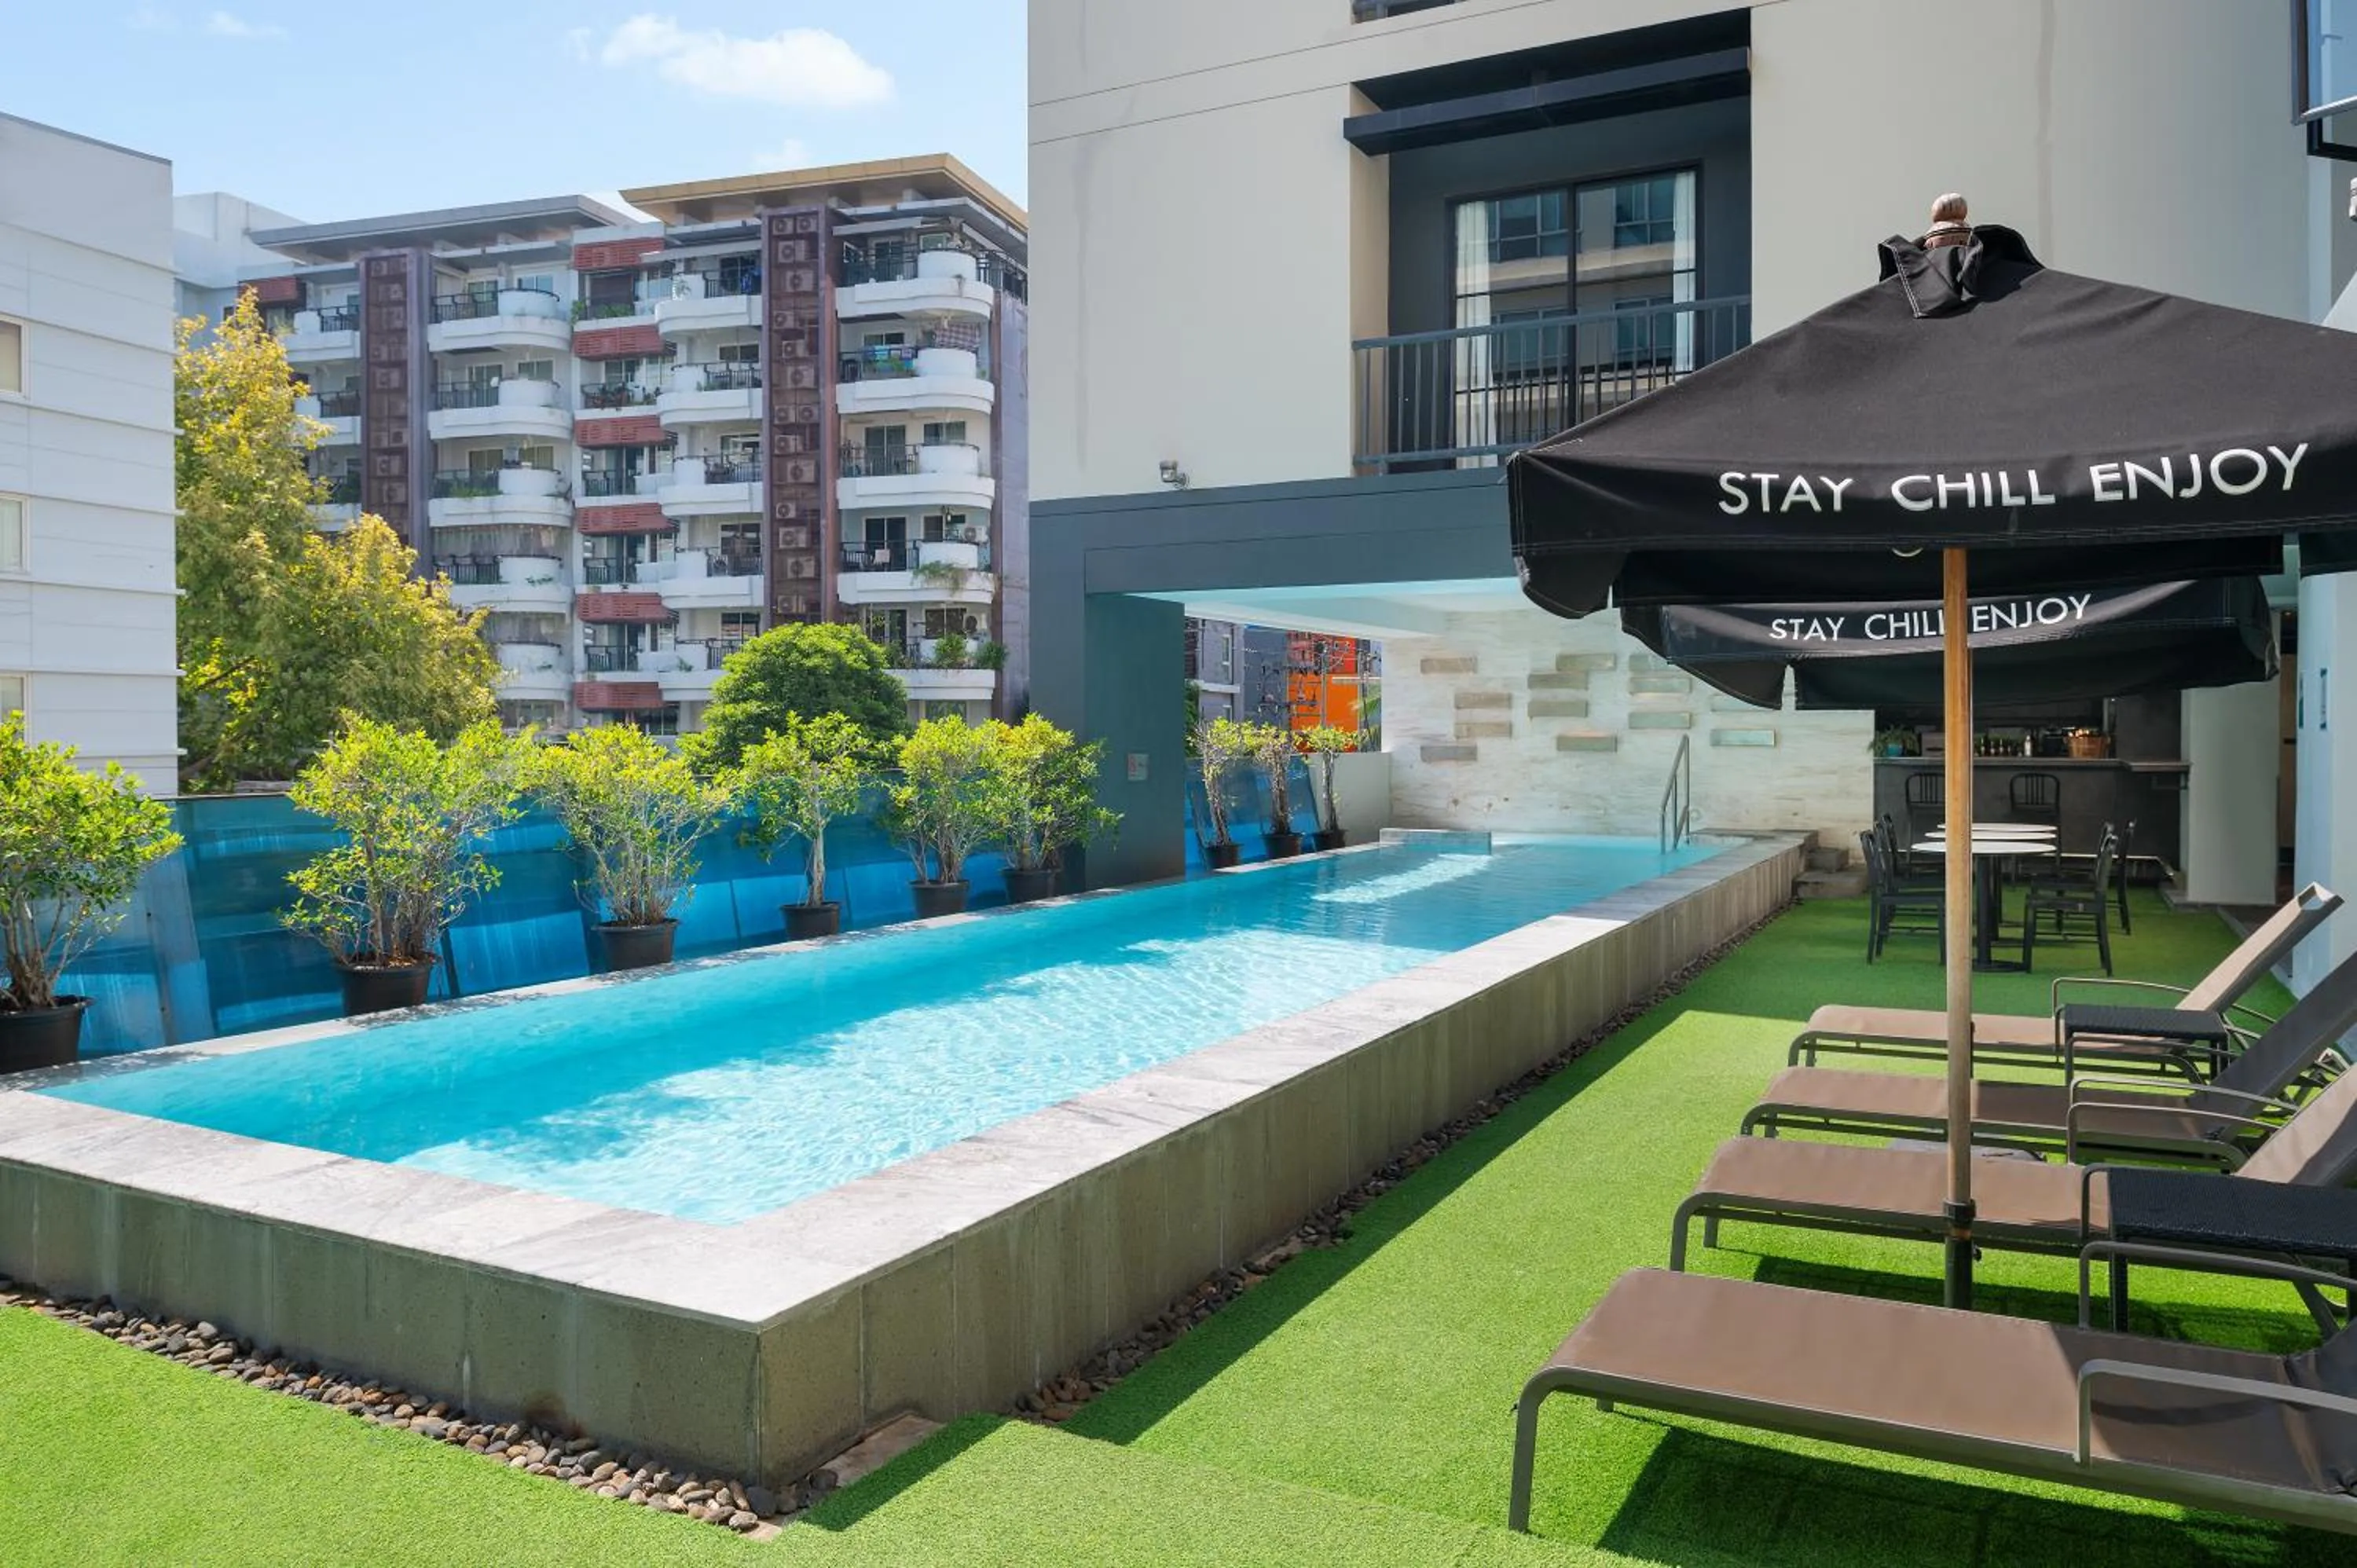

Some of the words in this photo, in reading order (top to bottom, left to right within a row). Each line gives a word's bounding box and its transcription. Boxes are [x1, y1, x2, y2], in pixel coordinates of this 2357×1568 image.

[1717, 471, 1853, 515] STAY
[1890, 469, 2055, 511] CHILL
[2088, 442, 2309, 501] ENJOY
[1769, 617, 1845, 642] STAY
[1972, 593, 2091, 632] ENJOY
